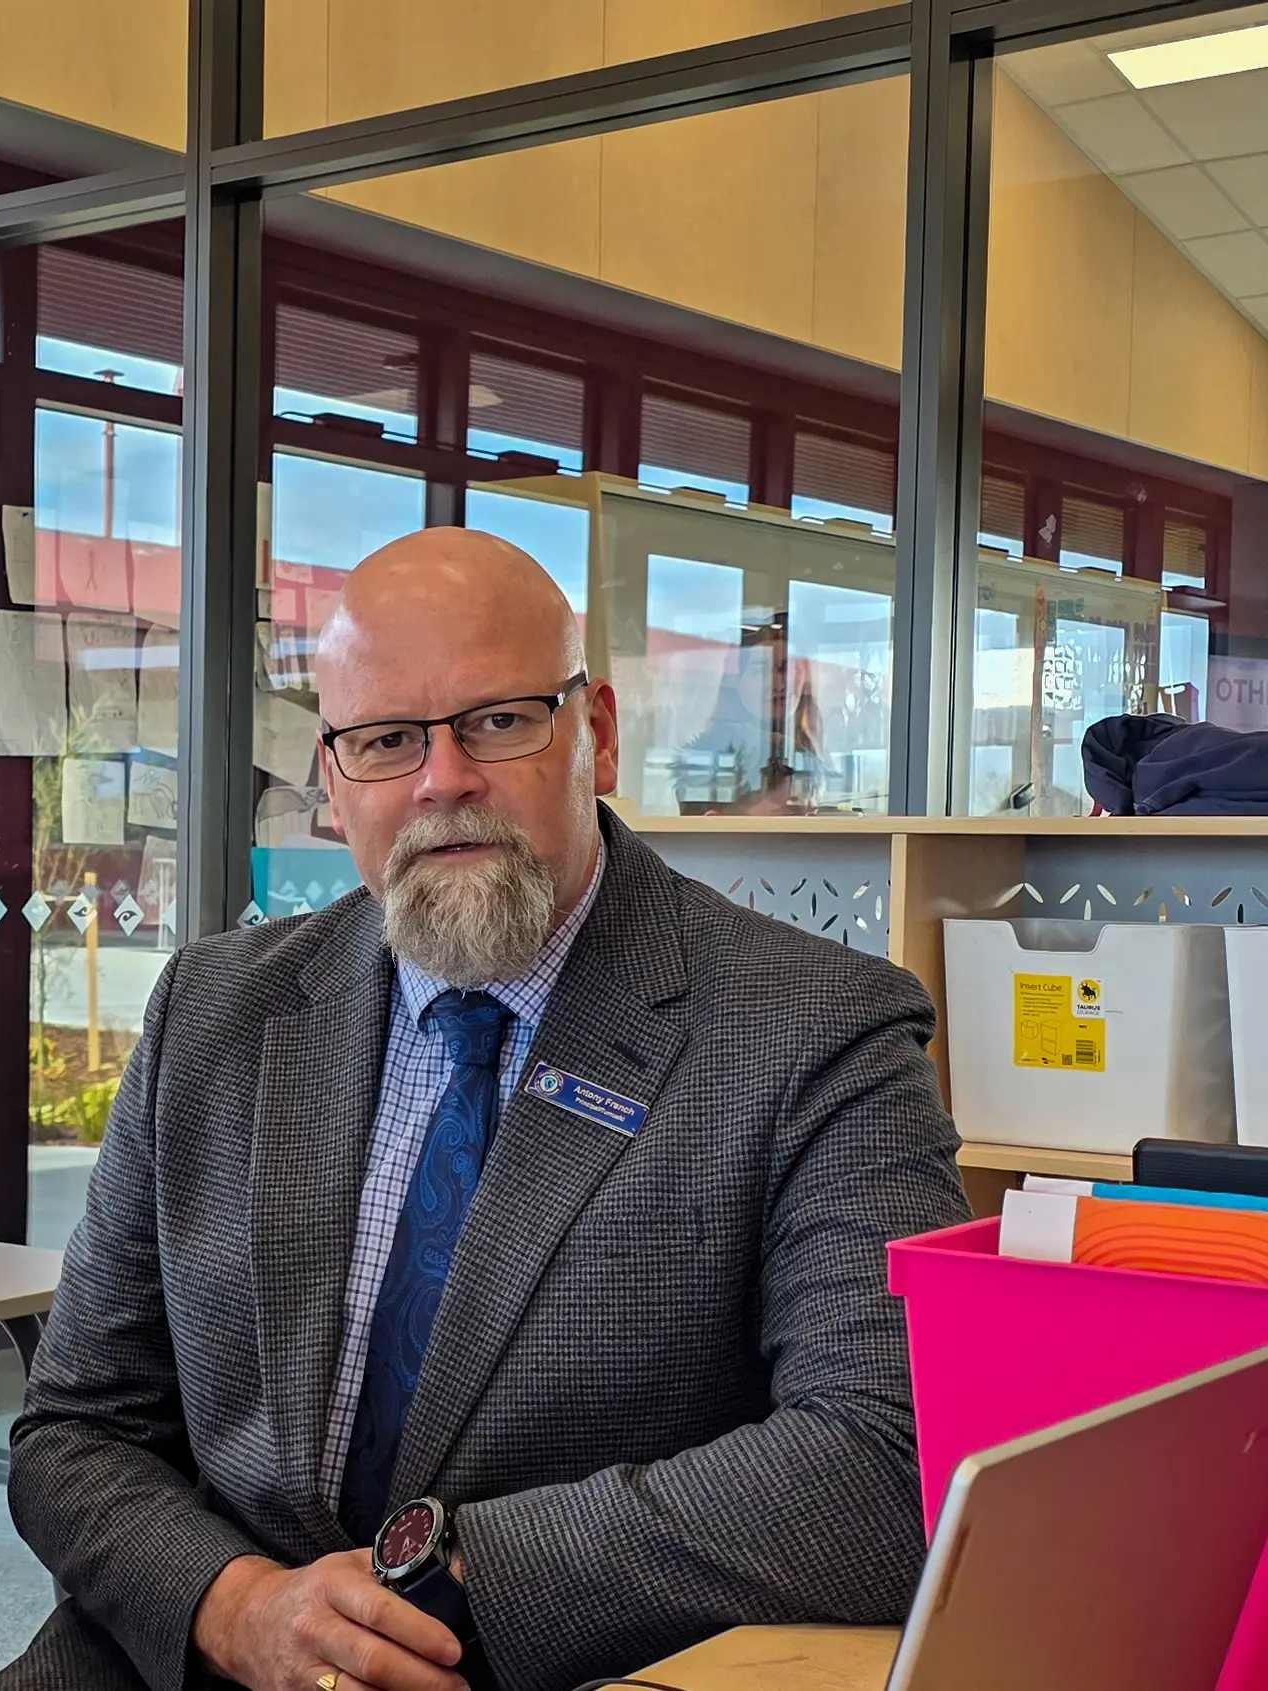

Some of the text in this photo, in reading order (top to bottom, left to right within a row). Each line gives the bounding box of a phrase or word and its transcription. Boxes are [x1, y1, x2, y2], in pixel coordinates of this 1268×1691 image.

[1020, 982, 1062, 992] Insert Cube
[573, 1085, 635, 1116] Antony French
